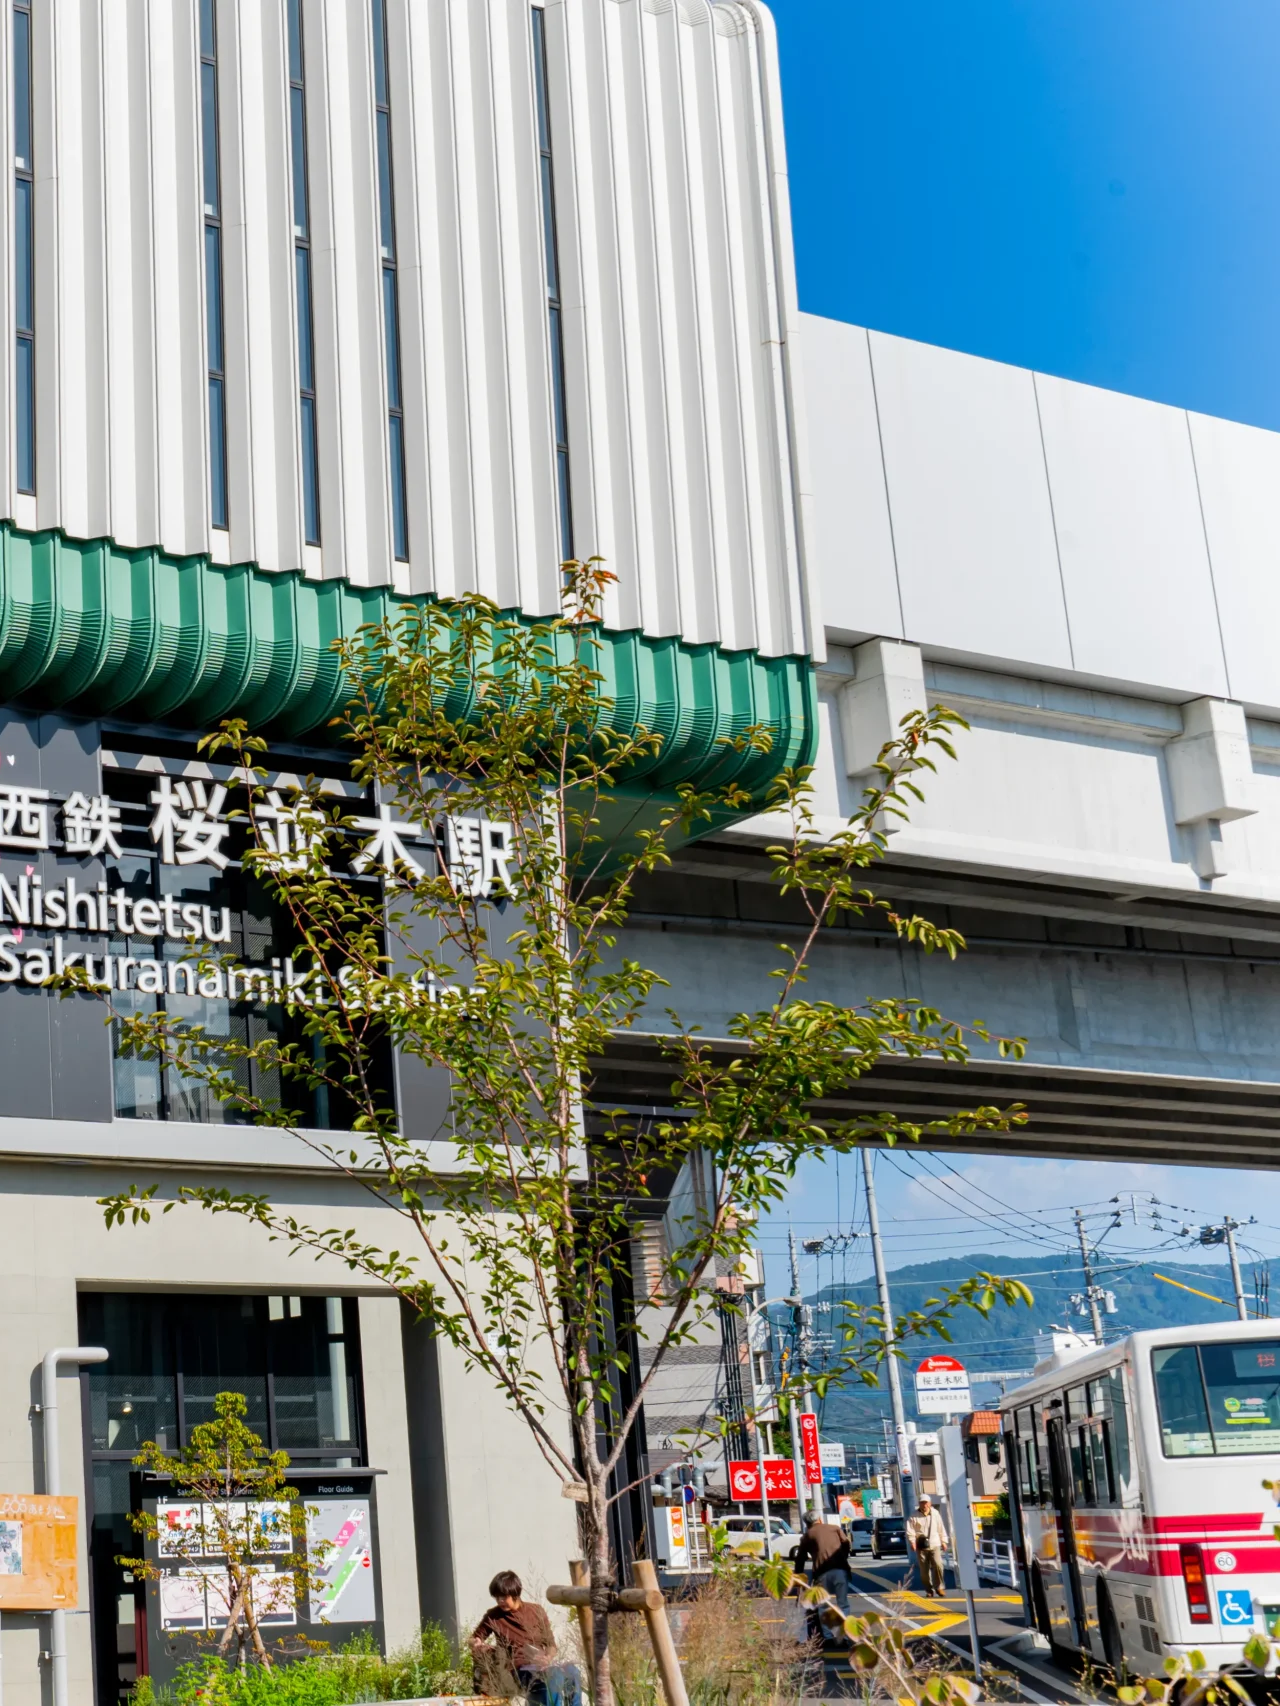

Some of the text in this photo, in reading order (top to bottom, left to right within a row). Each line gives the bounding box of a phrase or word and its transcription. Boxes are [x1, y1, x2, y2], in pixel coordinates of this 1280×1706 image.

[318, 1485, 354, 1493] Floor Guide
[157, 1495, 168, 1504] 1F
[1218, 1556, 1234, 1566] 60
[160, 1568, 171, 1577] 2F
